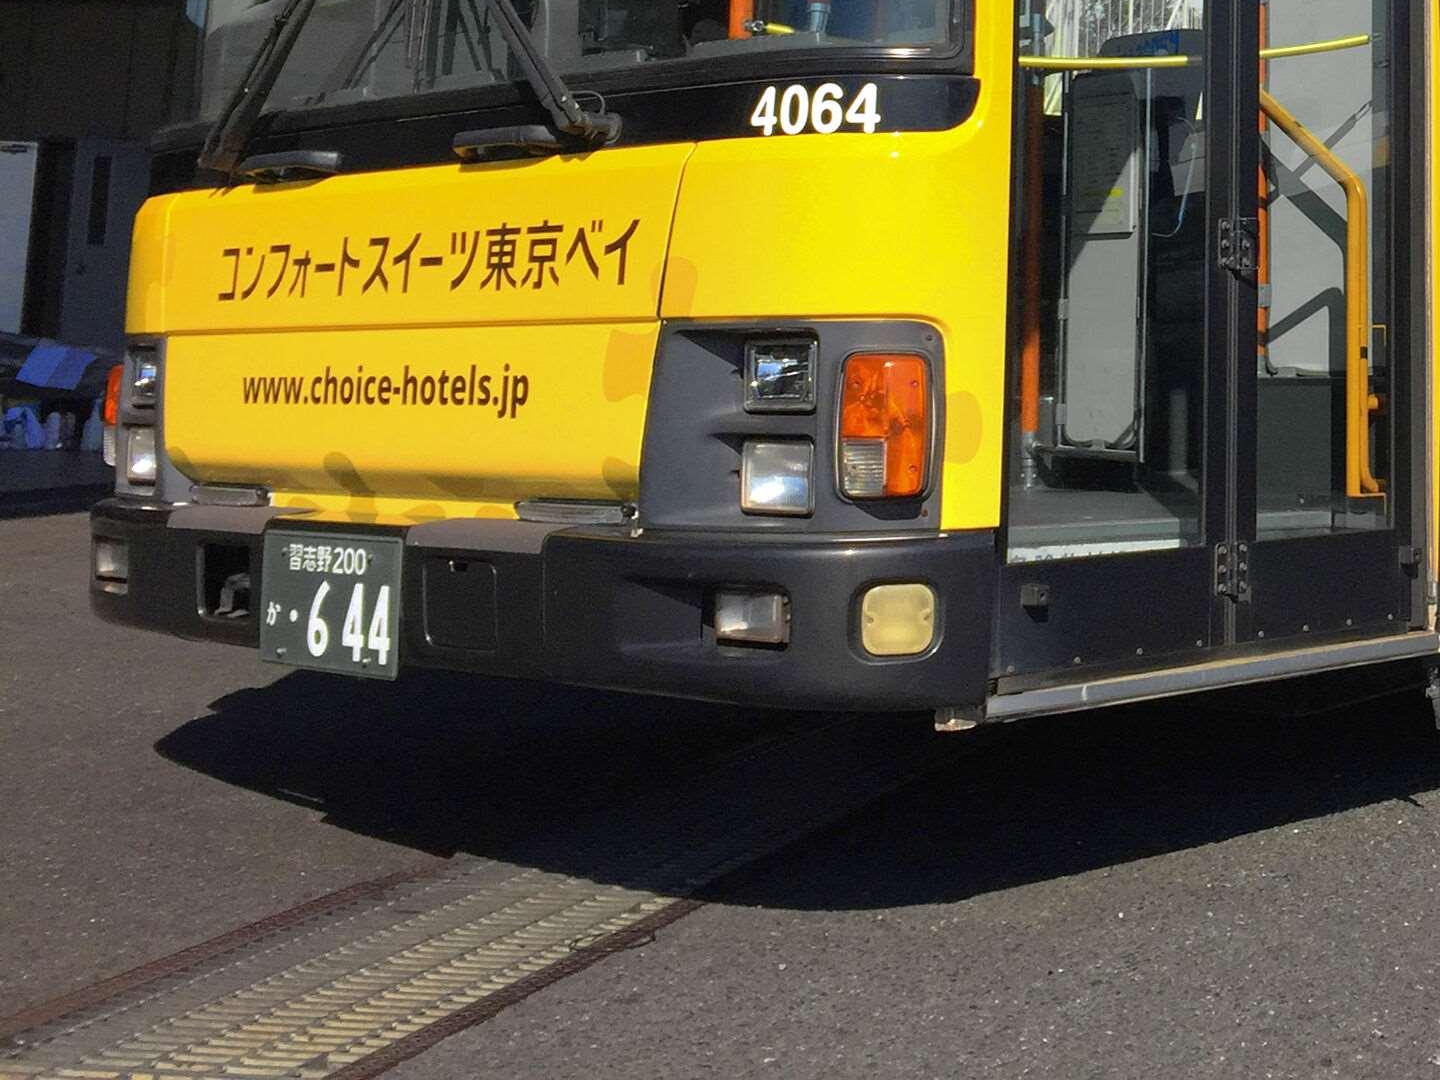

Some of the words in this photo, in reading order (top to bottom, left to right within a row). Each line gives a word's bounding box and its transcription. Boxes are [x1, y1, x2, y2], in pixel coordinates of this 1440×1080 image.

[751, 83, 881, 136] 4064
[218, 219, 641, 301] コンフォートスイーツ東京ベイ
[243, 363, 529, 418] www.choice-hotels.jp
